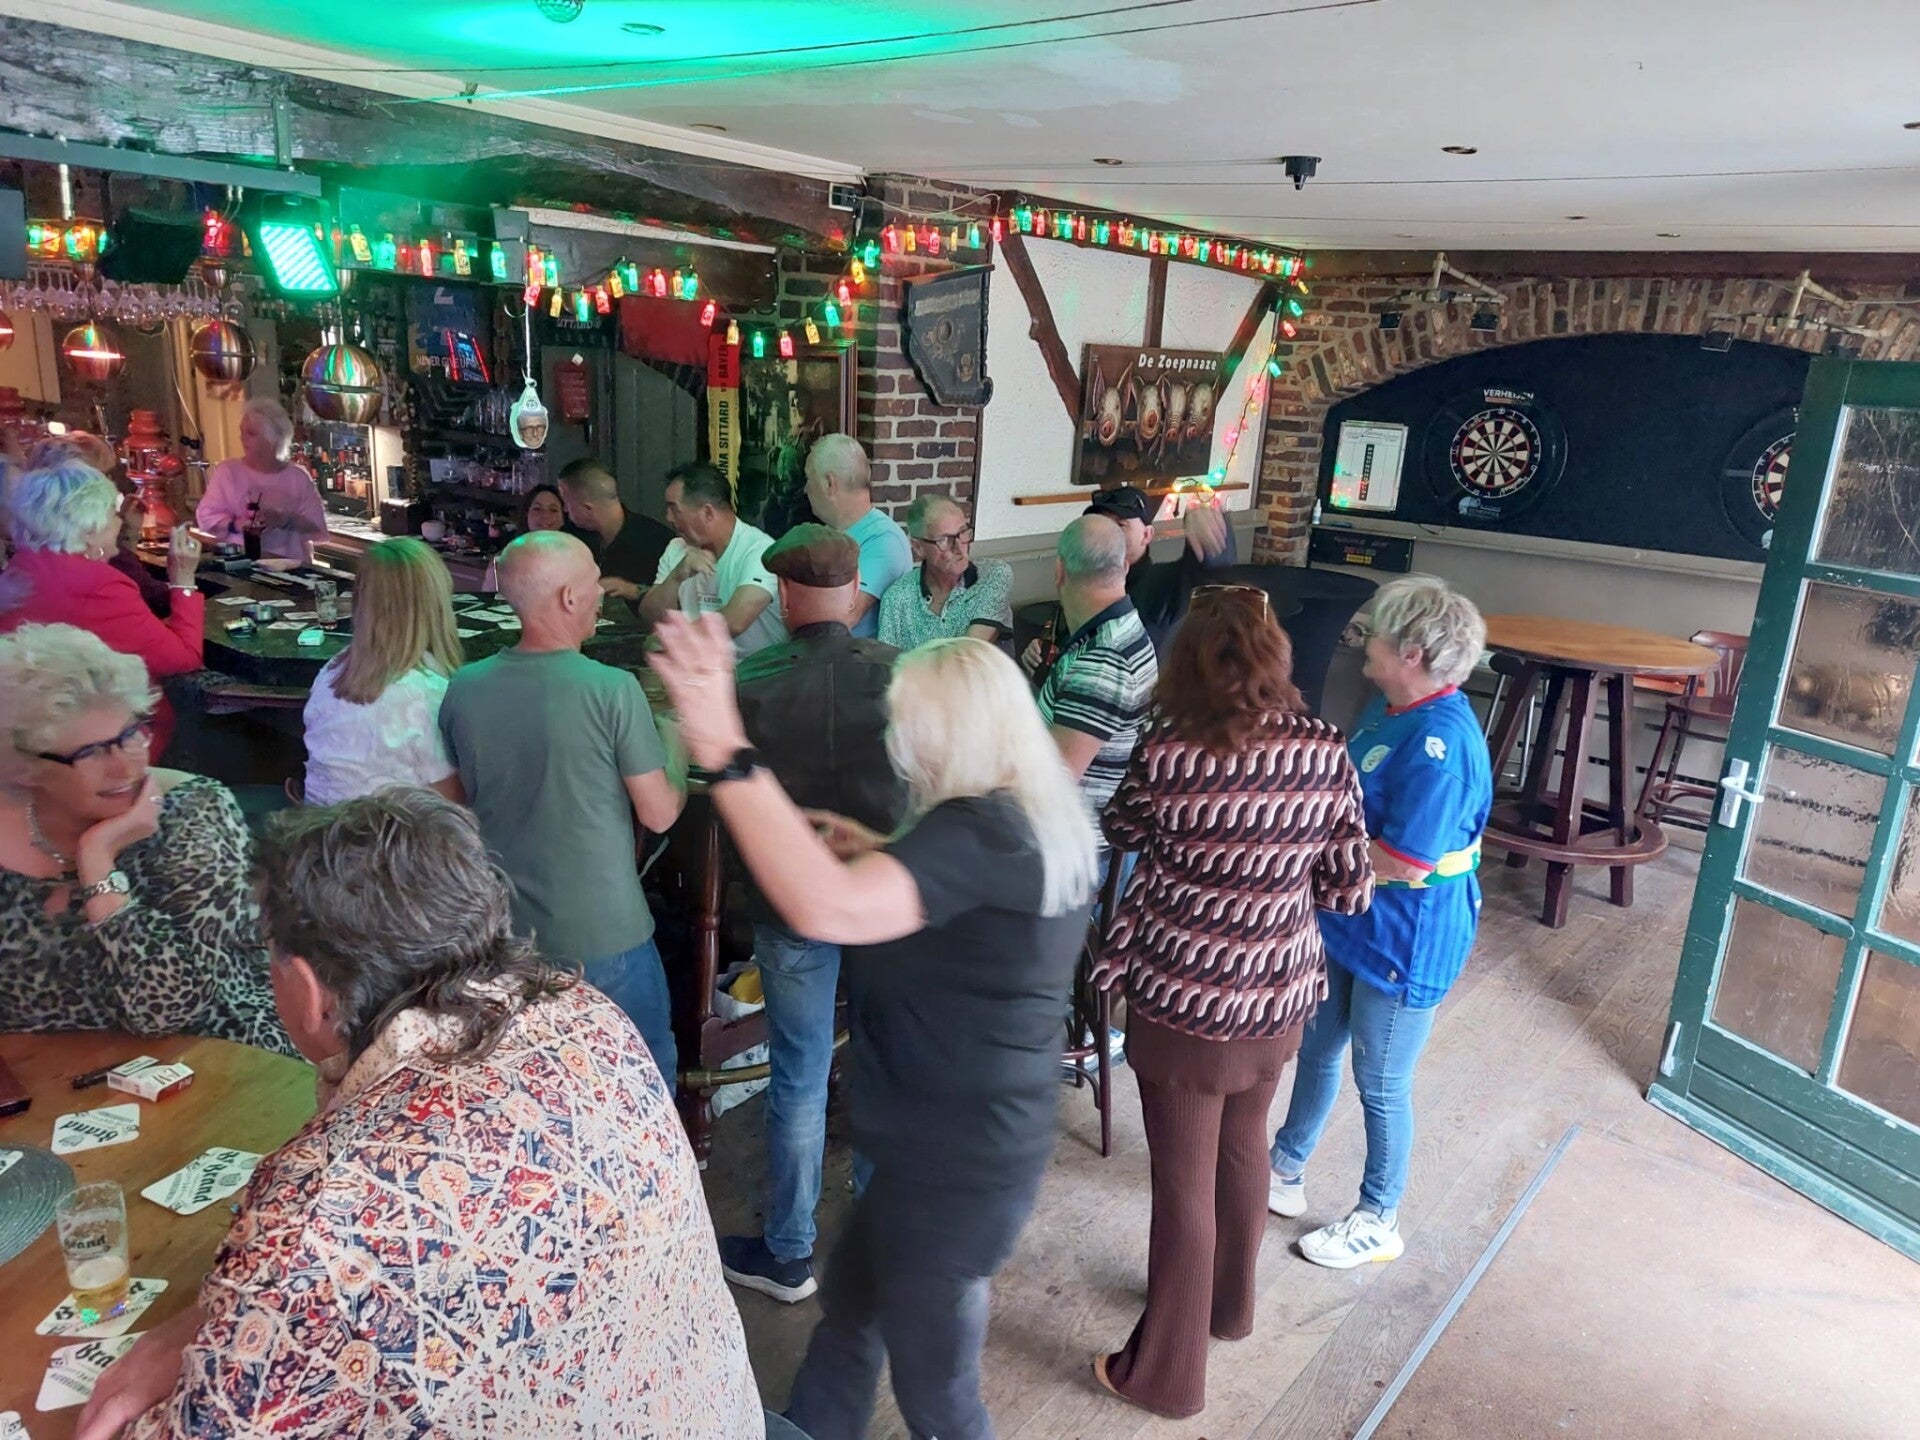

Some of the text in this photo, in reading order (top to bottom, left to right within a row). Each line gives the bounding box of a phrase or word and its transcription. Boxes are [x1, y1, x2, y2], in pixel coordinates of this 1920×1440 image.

[1138, 353, 1217, 373] De Zoepnaaze
[718, 400, 729, 449] SITTARD
[59, 1120, 118, 1143] Brand
[192, 1163, 228, 1204] Brand
[75, 1341, 116, 1368] Bra
